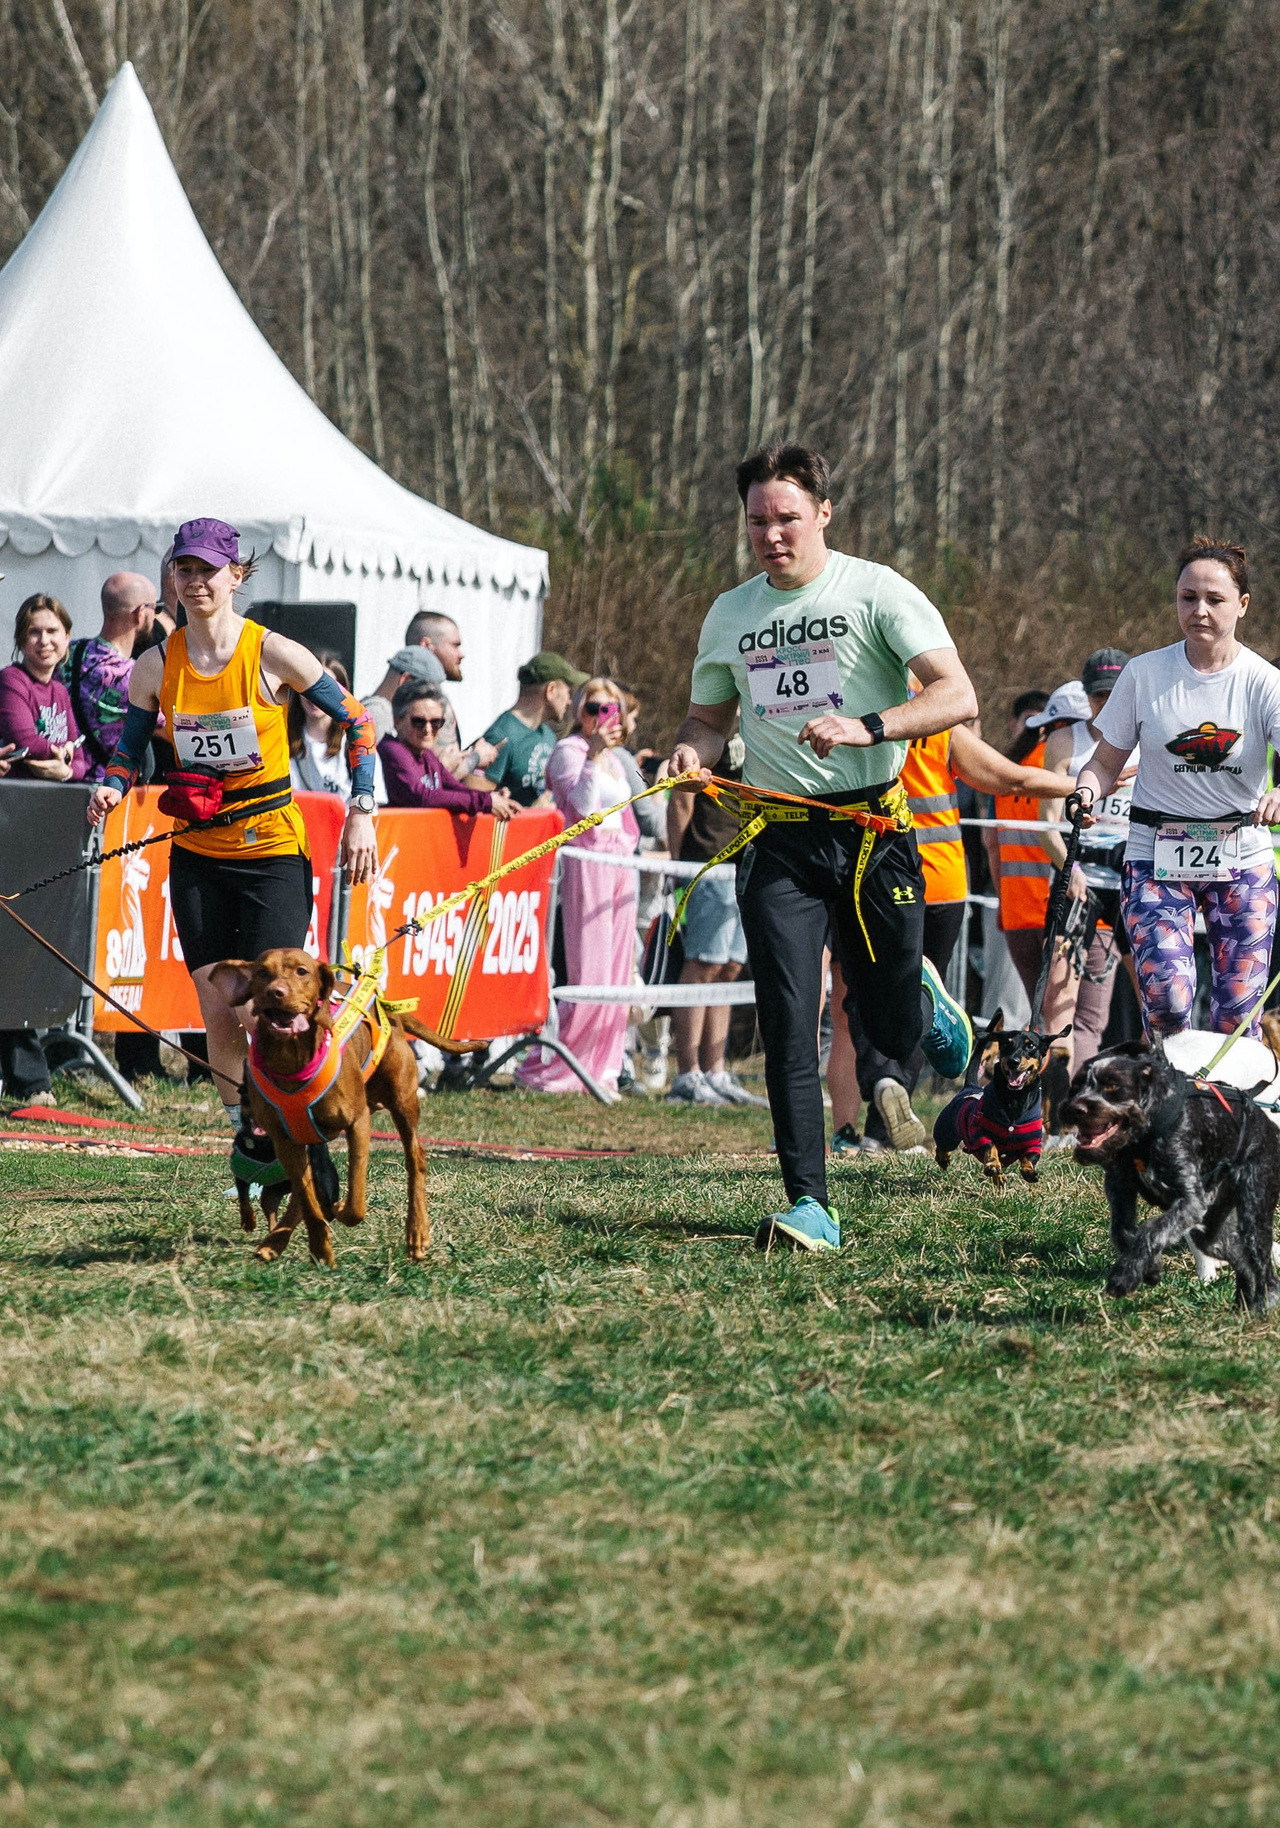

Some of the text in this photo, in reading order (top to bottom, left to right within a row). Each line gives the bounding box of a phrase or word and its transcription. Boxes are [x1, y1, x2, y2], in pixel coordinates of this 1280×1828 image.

[738, 615, 849, 655] adidas
[776, 669, 810, 698] 48
[190, 732, 236, 758] 251
[716, 829, 752, 861] TELPOSIZ
[1174, 845, 1221, 867] 124
[402, 890, 468, 976] 1945
[482, 890, 541, 975] 2025
